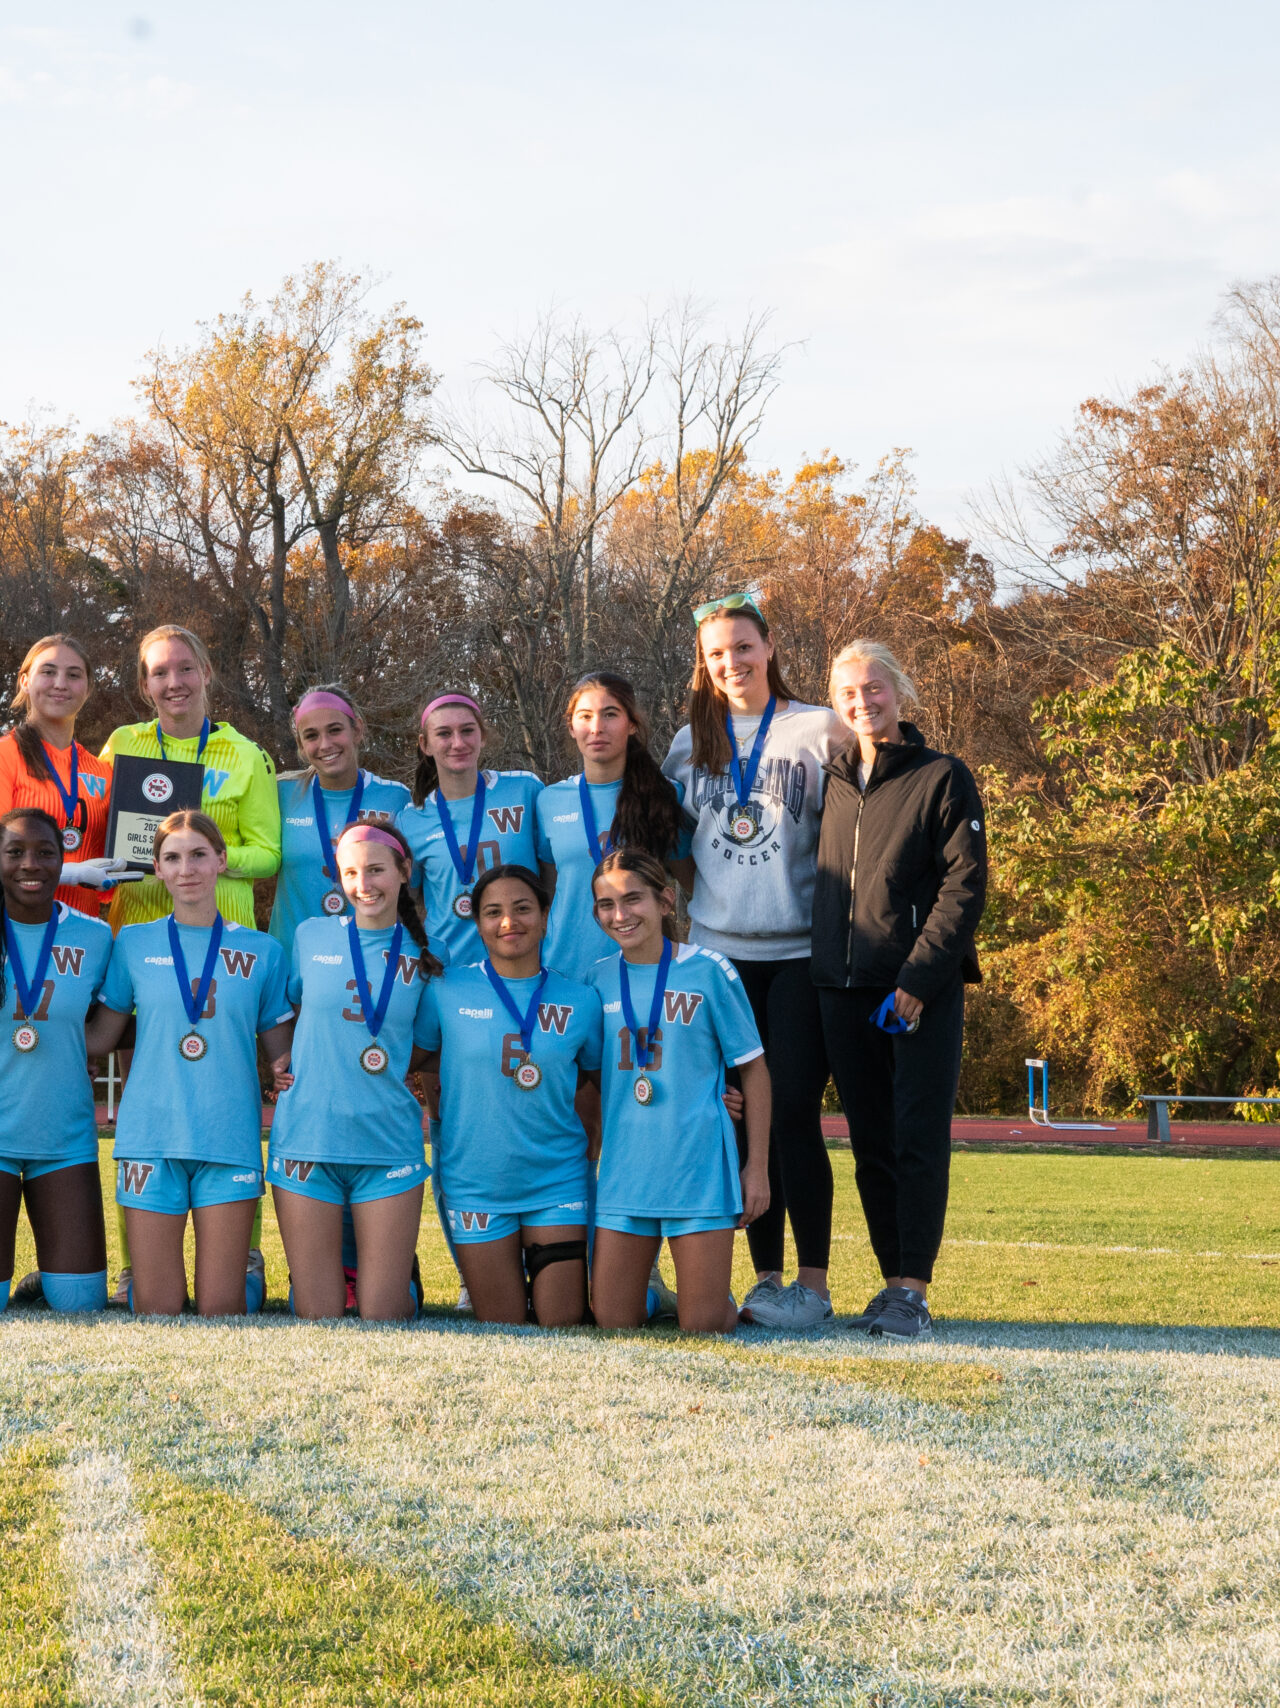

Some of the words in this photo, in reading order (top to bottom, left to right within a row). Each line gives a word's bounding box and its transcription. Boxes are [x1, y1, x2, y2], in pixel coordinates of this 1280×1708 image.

[78, 772, 107, 800] W
[487, 805, 524, 834] W
[127, 833, 148, 844] GIRLS
[711, 838, 781, 866] SOCCER
[51, 945, 86, 977] W
[219, 947, 257, 979] W
[382, 950, 420, 986] W
[13, 979, 56, 1021] 17
[341, 978, 373, 1023] 3
[458, 1007, 493, 1019] capelli
[664, 990, 704, 1026] W
[537, 1003, 574, 1036] W
[122, 1160, 155, 1196] W
